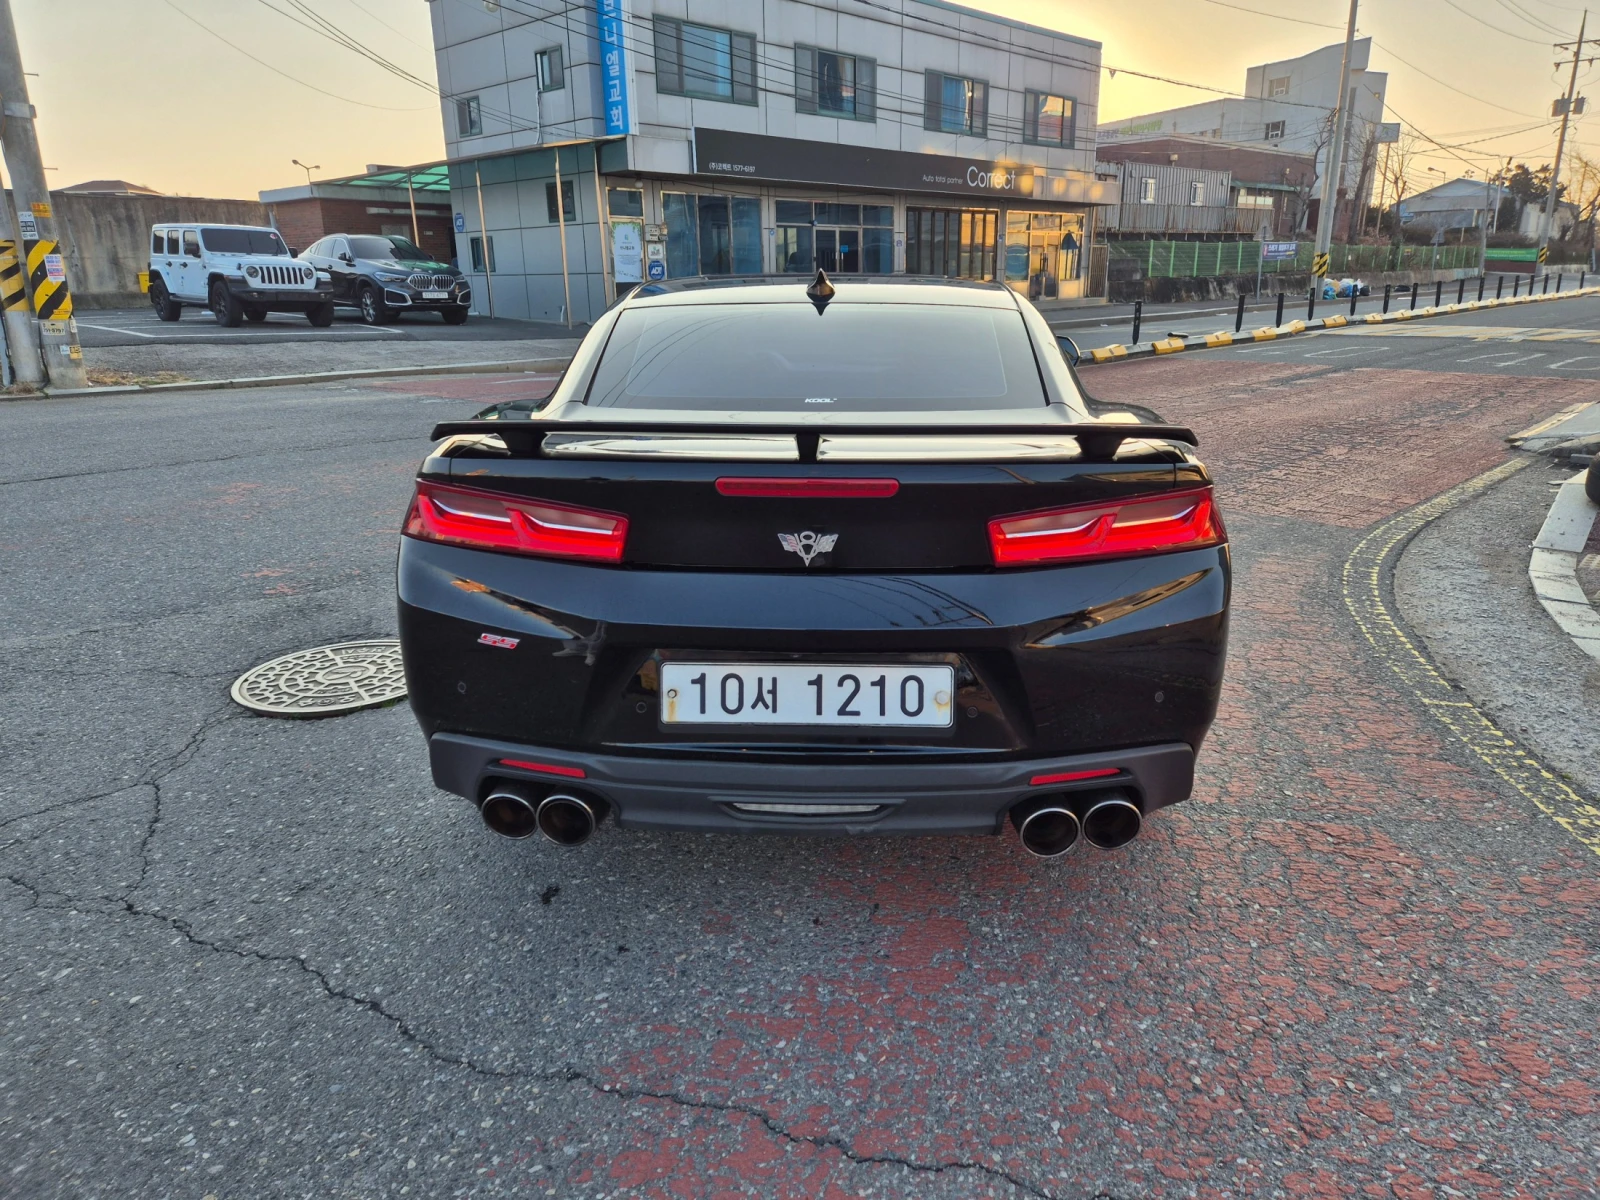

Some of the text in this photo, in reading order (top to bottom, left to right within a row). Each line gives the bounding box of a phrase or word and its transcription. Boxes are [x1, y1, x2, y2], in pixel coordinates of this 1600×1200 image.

[922, 174, 964, 184] Auto total partner
[967, 166, 1016, 189] Correct
[690, 672, 925, 717] 10서 1210
